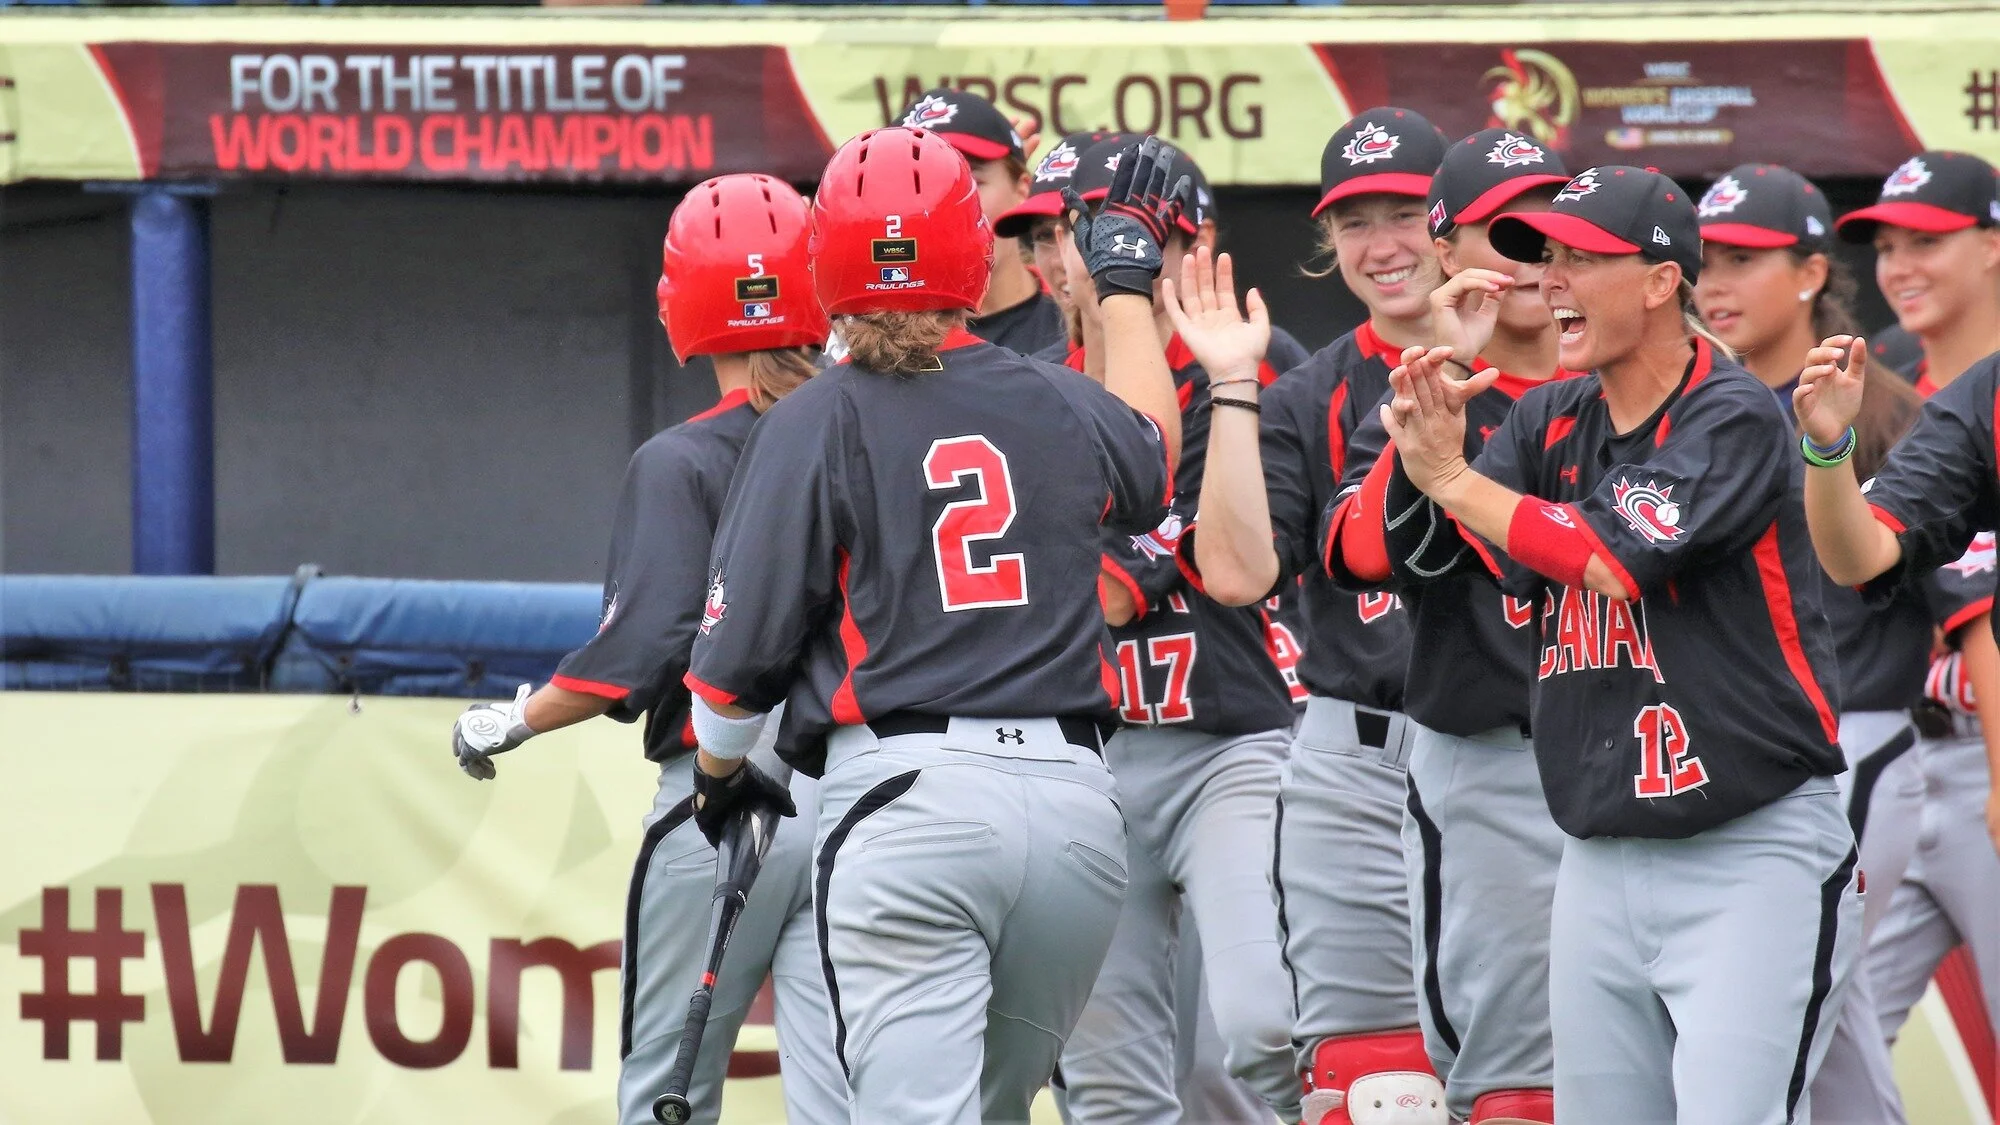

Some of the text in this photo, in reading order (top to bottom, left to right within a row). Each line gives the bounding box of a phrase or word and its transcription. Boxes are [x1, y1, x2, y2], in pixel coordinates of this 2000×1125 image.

[230, 54, 687, 113] FOR THE TITLE OF
[210, 115, 713, 171] WORLD CHAMPION
[883, 246, 906, 255] WBSC
[885, 214, 902, 238] 2
[747, 253, 765, 279] 5
[864, 279, 926, 291] RAWLINGS
[922, 433, 1029, 613] 2
[1116, 632, 1197, 725] 17
[1633, 701, 1711, 799] 12
[19, 882, 782, 1079] #Wom
